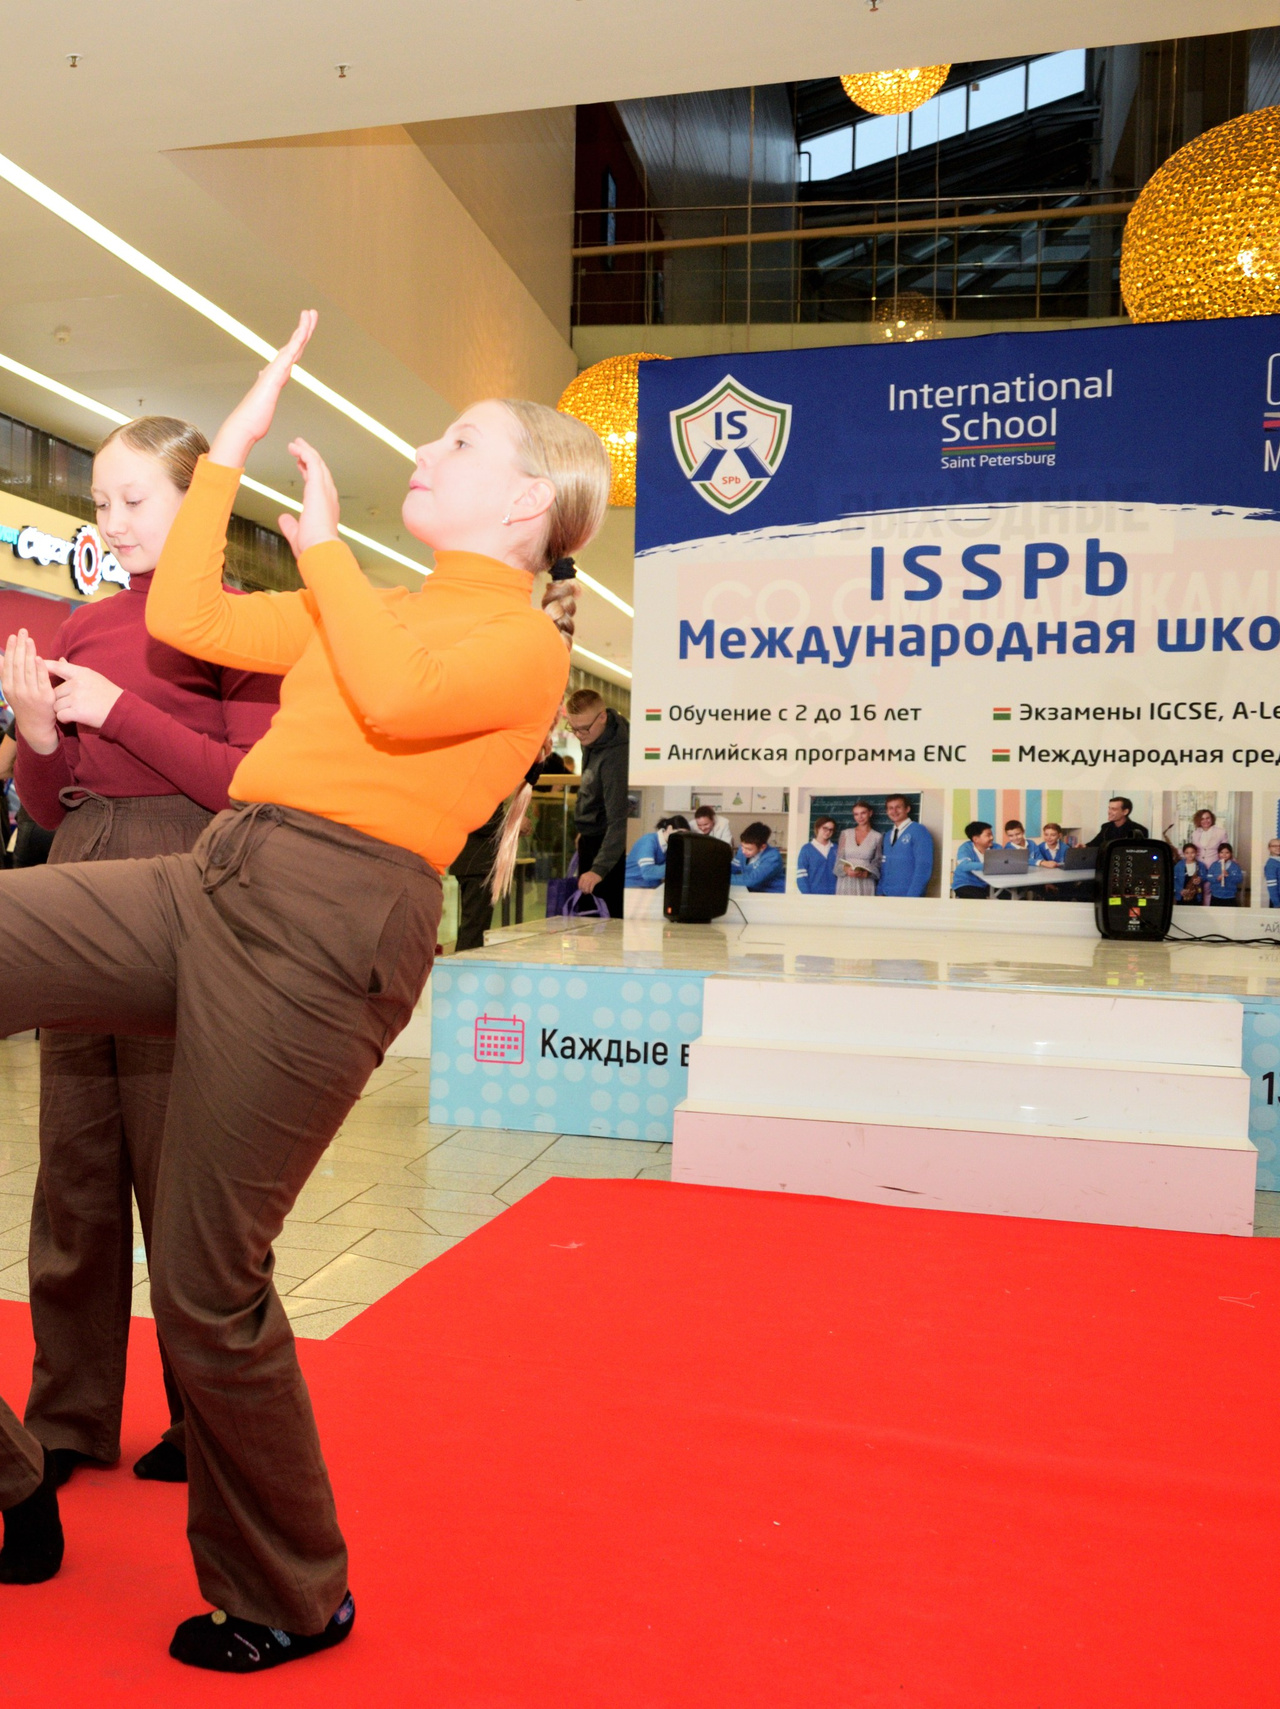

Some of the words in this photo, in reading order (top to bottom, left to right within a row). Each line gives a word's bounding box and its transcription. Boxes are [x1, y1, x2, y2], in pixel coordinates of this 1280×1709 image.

[889, 369, 1113, 411] International
[715, 410, 748, 440] IS
[941, 408, 1056, 442] School
[941, 455, 976, 469] Saint
[980, 452, 1056, 467] Petersburg
[722, 476, 741, 485] SPb
[870, 538, 1129, 601] ISSPb
[832, 569, 1280, 629] СМЕШАРИКАМ
[678, 618, 1136, 668] Международная
[1158, 615, 1280, 653] шко
[670, 705, 771, 725] Обучение
[778, 708, 788, 721] с
[796, 704, 807, 721] 2
[814, 708, 841, 723] до
[850, 704, 876, 721] 16
[884, 708, 922, 721] лет
[1019, 703, 1141, 721] Экзамены
[1150, 702, 1224, 722] IGCSE,
[667, 744, 788, 761] Английская
[795, 747, 915, 765] программа
[924, 745, 967, 762] ENC
[1018, 745, 1224, 767] Международная
[541, 1028, 669, 1067] Каждые
[1262, 1071, 1280, 1105] 1
